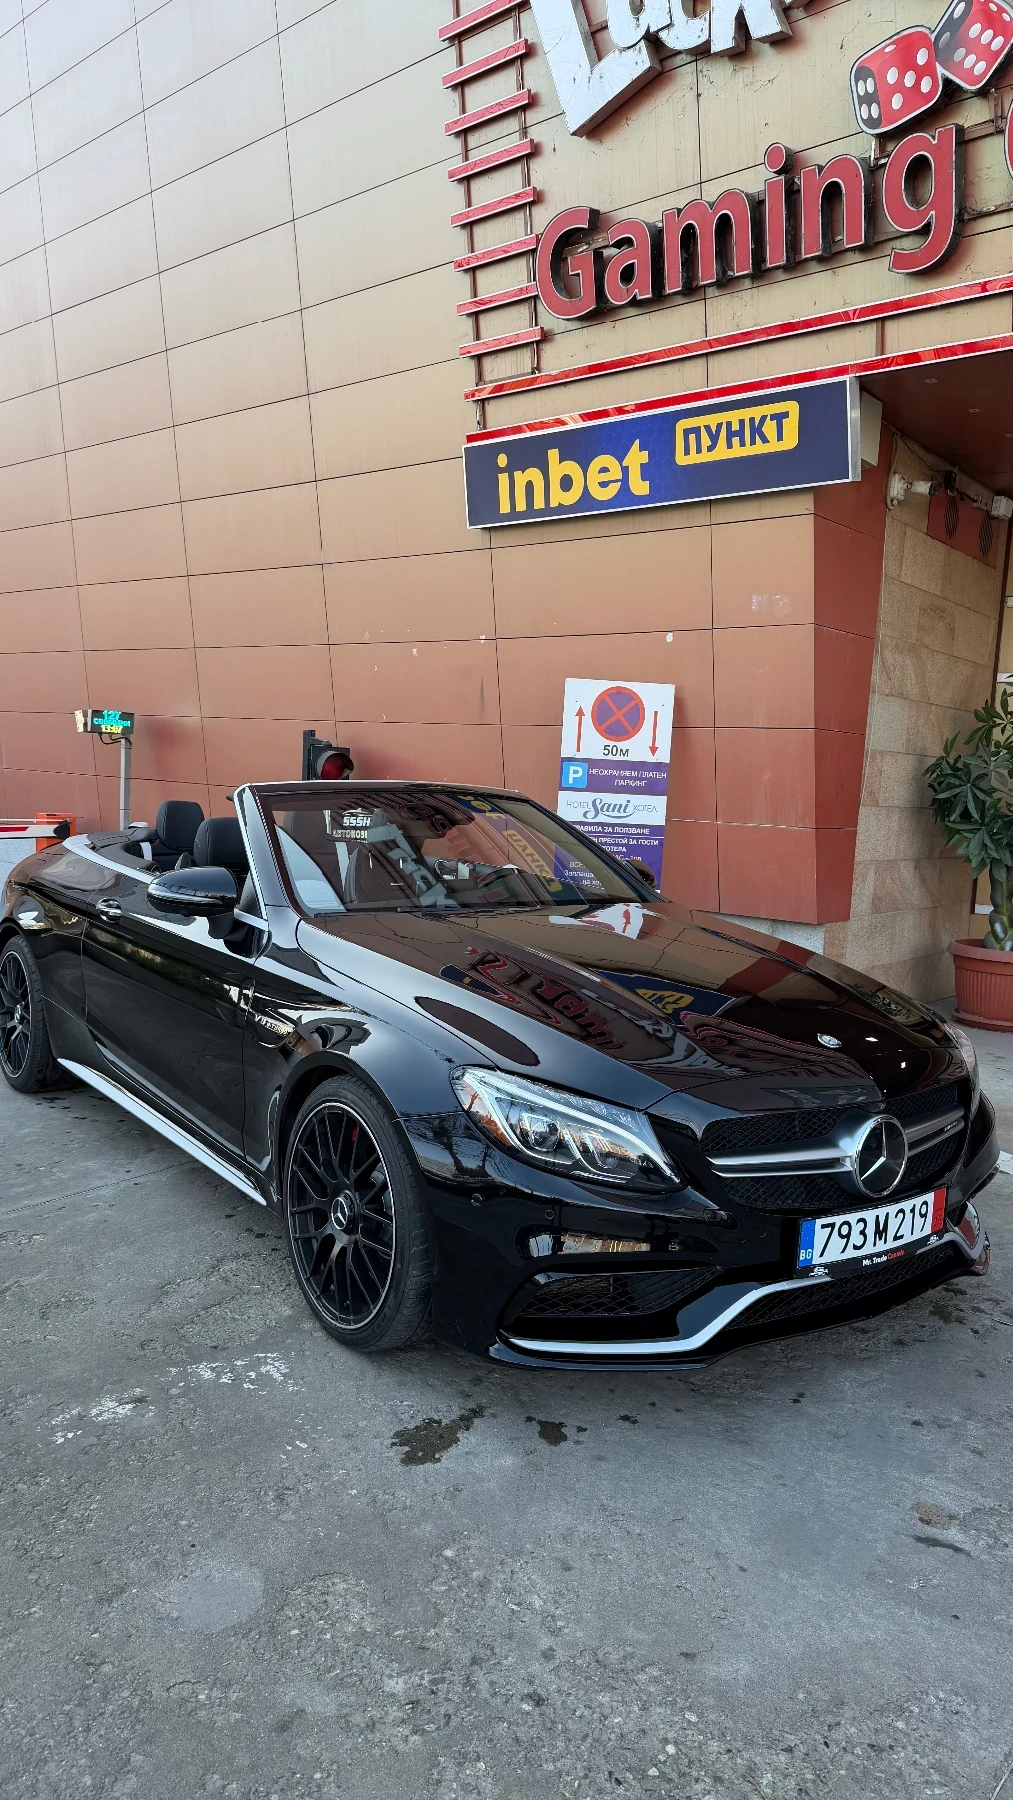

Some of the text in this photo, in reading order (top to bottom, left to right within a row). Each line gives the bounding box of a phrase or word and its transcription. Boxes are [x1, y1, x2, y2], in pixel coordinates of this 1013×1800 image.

[535, 122, 966, 320] Gaming
[683, 410, 790, 457] ПУНКТ
[497, 438, 650, 514] inbet
[102, 710, 121, 720] 127
[568, 765, 583, 784] P
[589, 768, 667, 779] НЕОХРАНЯЕМ ПЛАТЕН
[614, 779, 648, 787] ПАРКИНГ
[566, 797, 632, 819] HOTEL Sani
[799, 1248, 812, 1260] BG
